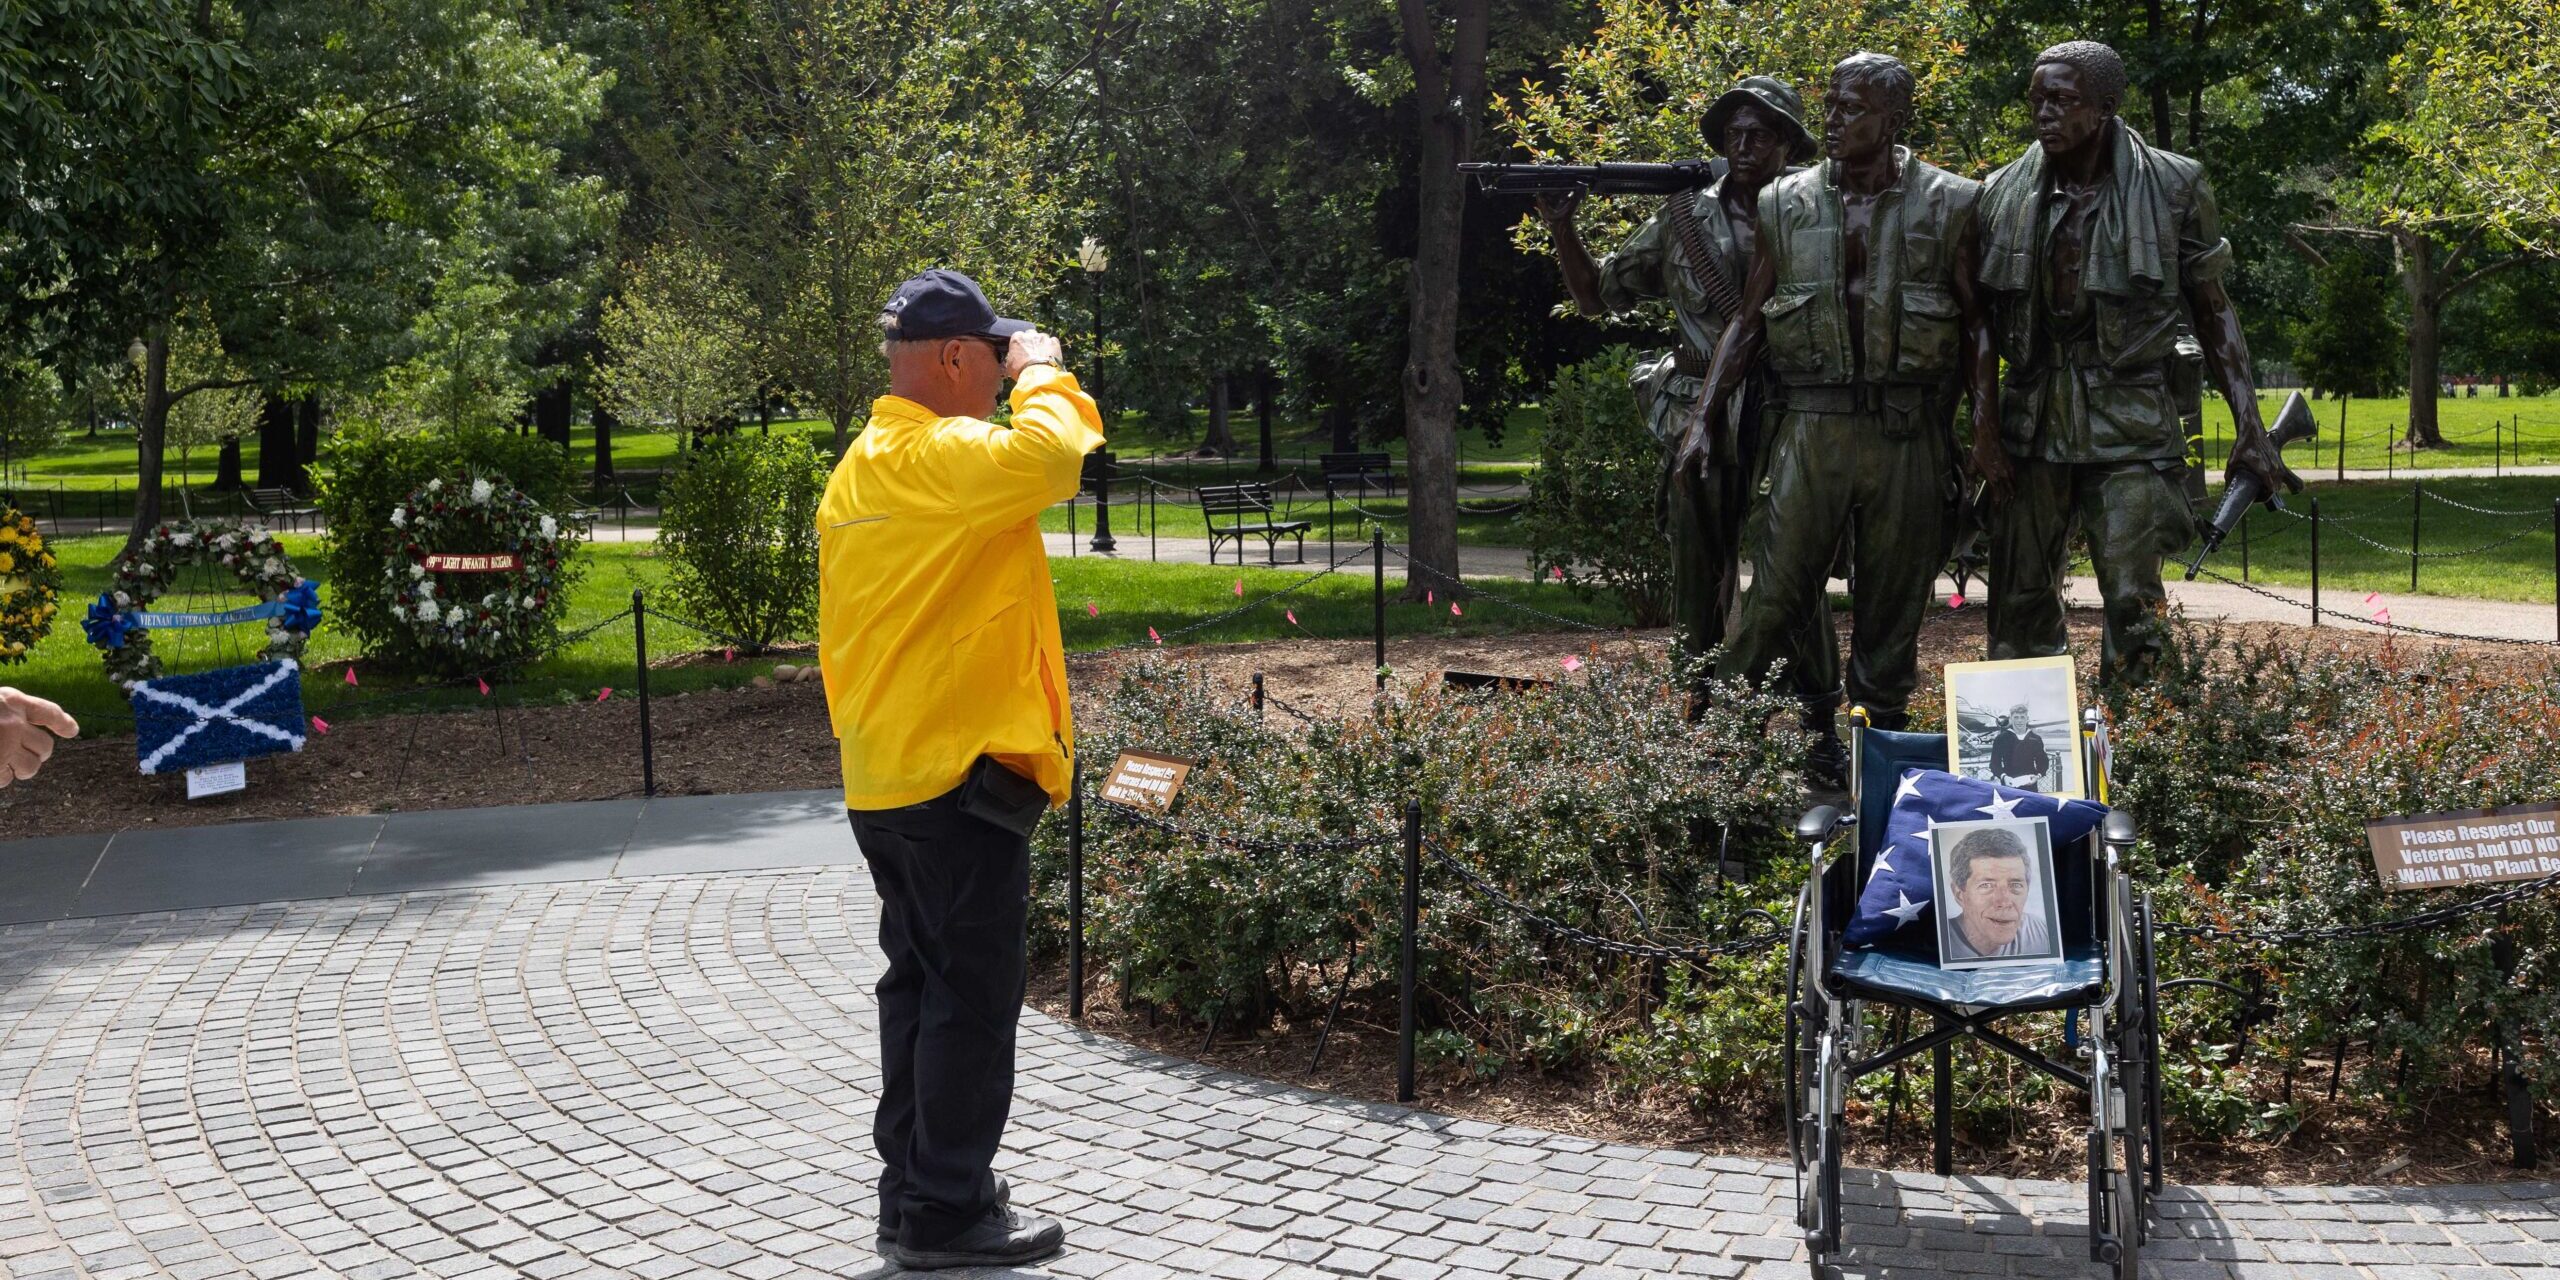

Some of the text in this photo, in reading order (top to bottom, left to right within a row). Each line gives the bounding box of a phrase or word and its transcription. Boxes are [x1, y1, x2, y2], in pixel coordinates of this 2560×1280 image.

[140, 614, 172, 626] VIETNAM
[175, 614, 211, 626] VETERANS
[2400, 819, 2555, 845] Please Respect Our
[2400, 846, 2475, 865] Veterans
[2477, 841, 2509, 858] And
[2509, 838, 2533, 855] DO
[2397, 856, 2560, 884] Walk In The Plant Be
